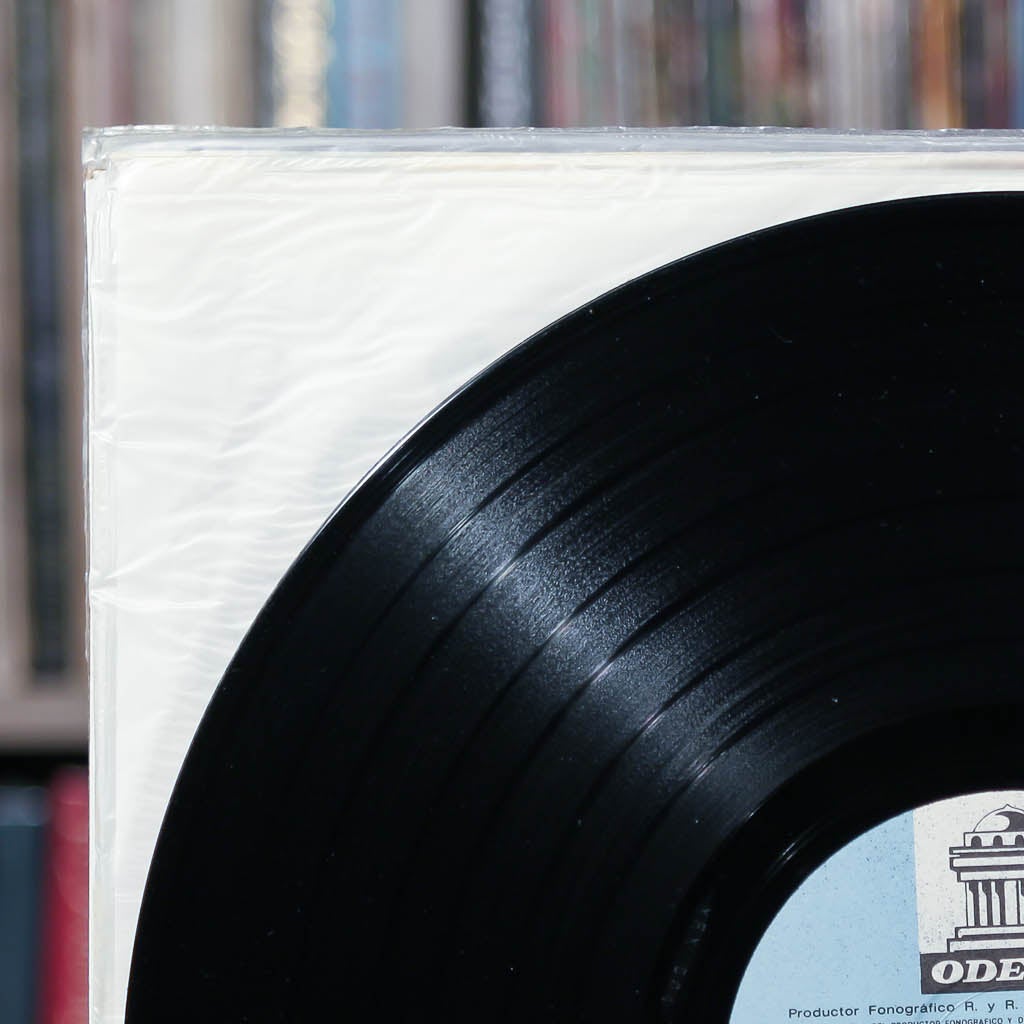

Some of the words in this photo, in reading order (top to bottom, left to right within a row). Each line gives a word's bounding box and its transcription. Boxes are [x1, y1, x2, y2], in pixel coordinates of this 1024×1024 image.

[788, 1007, 859, 1018] Productor
[868, 1002, 955, 1016] Fonográfico
[964, 1000, 977, 1011] R.
[987, 1002, 995, 1013] y
[1005, 999, 1018, 1010] R.
